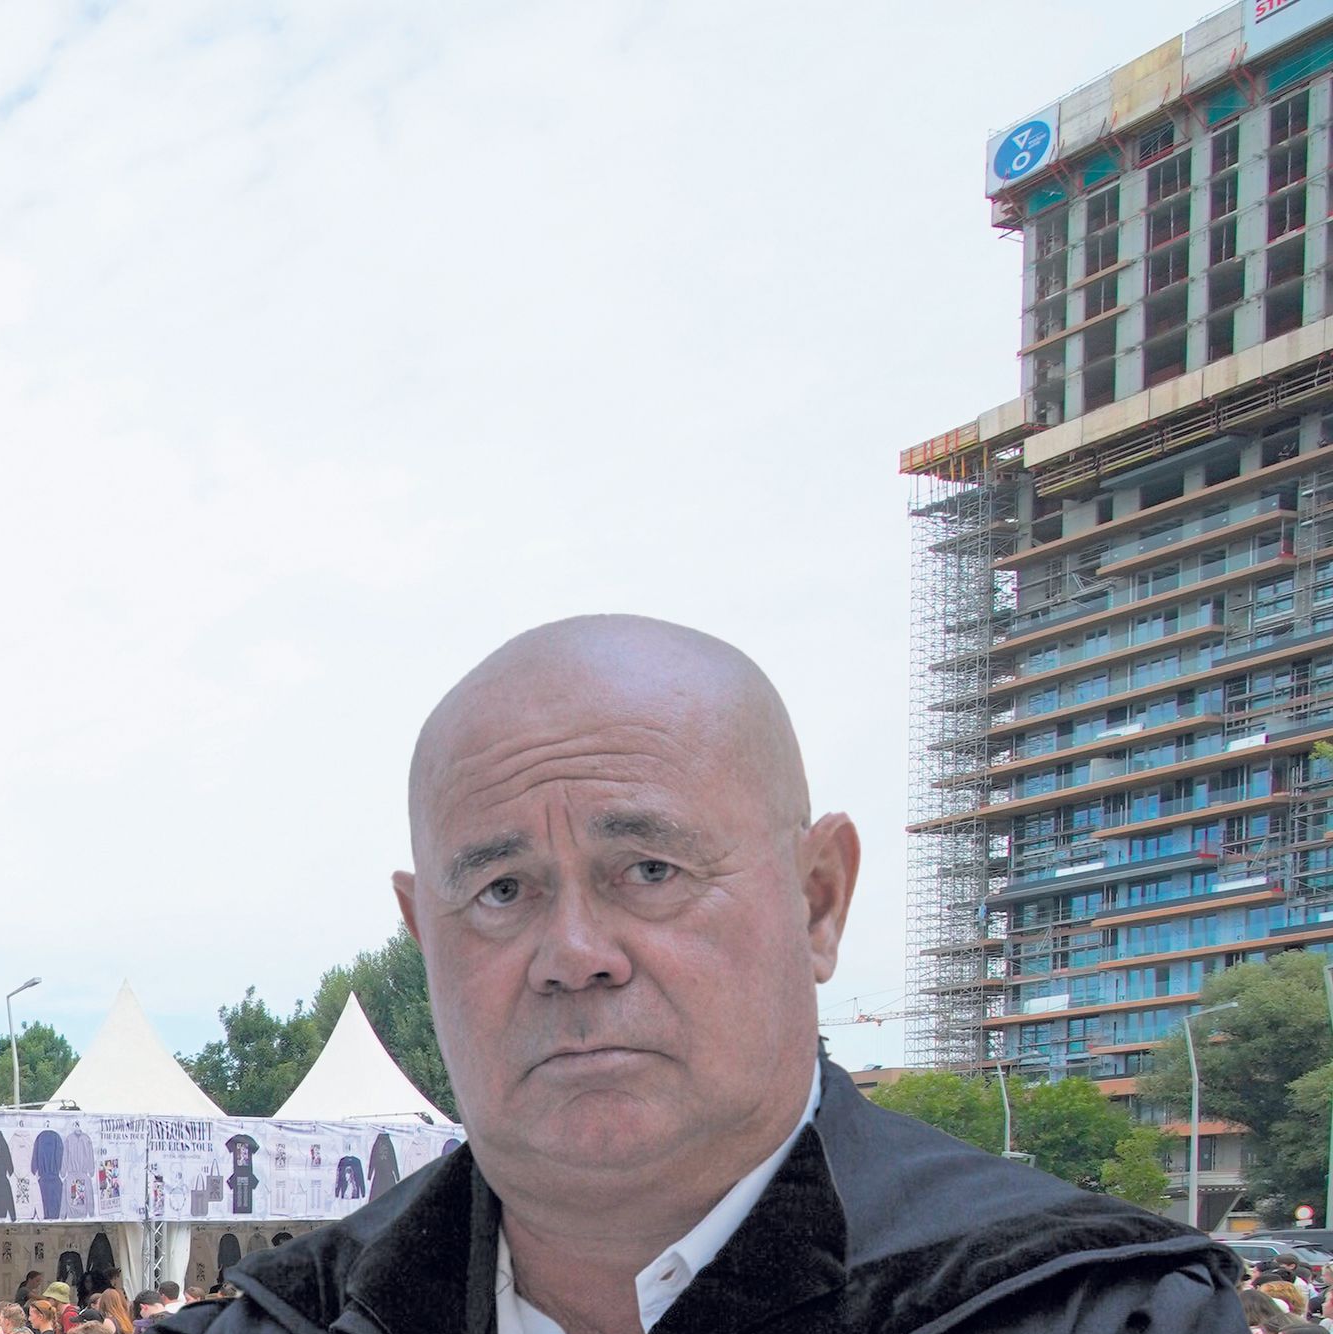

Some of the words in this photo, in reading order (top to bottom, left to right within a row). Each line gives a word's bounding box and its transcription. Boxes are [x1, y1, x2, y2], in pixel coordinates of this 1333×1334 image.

[100, 1119, 125, 1132] TAYLOR
[149, 1120, 183, 1140] TAYLOR
[184, 1121, 214, 1141] SWIFT
[150, 1141, 167, 1151] THE
[168, 1142, 190, 1152] ERAS
[192, 1142, 213, 1152] TOUR
